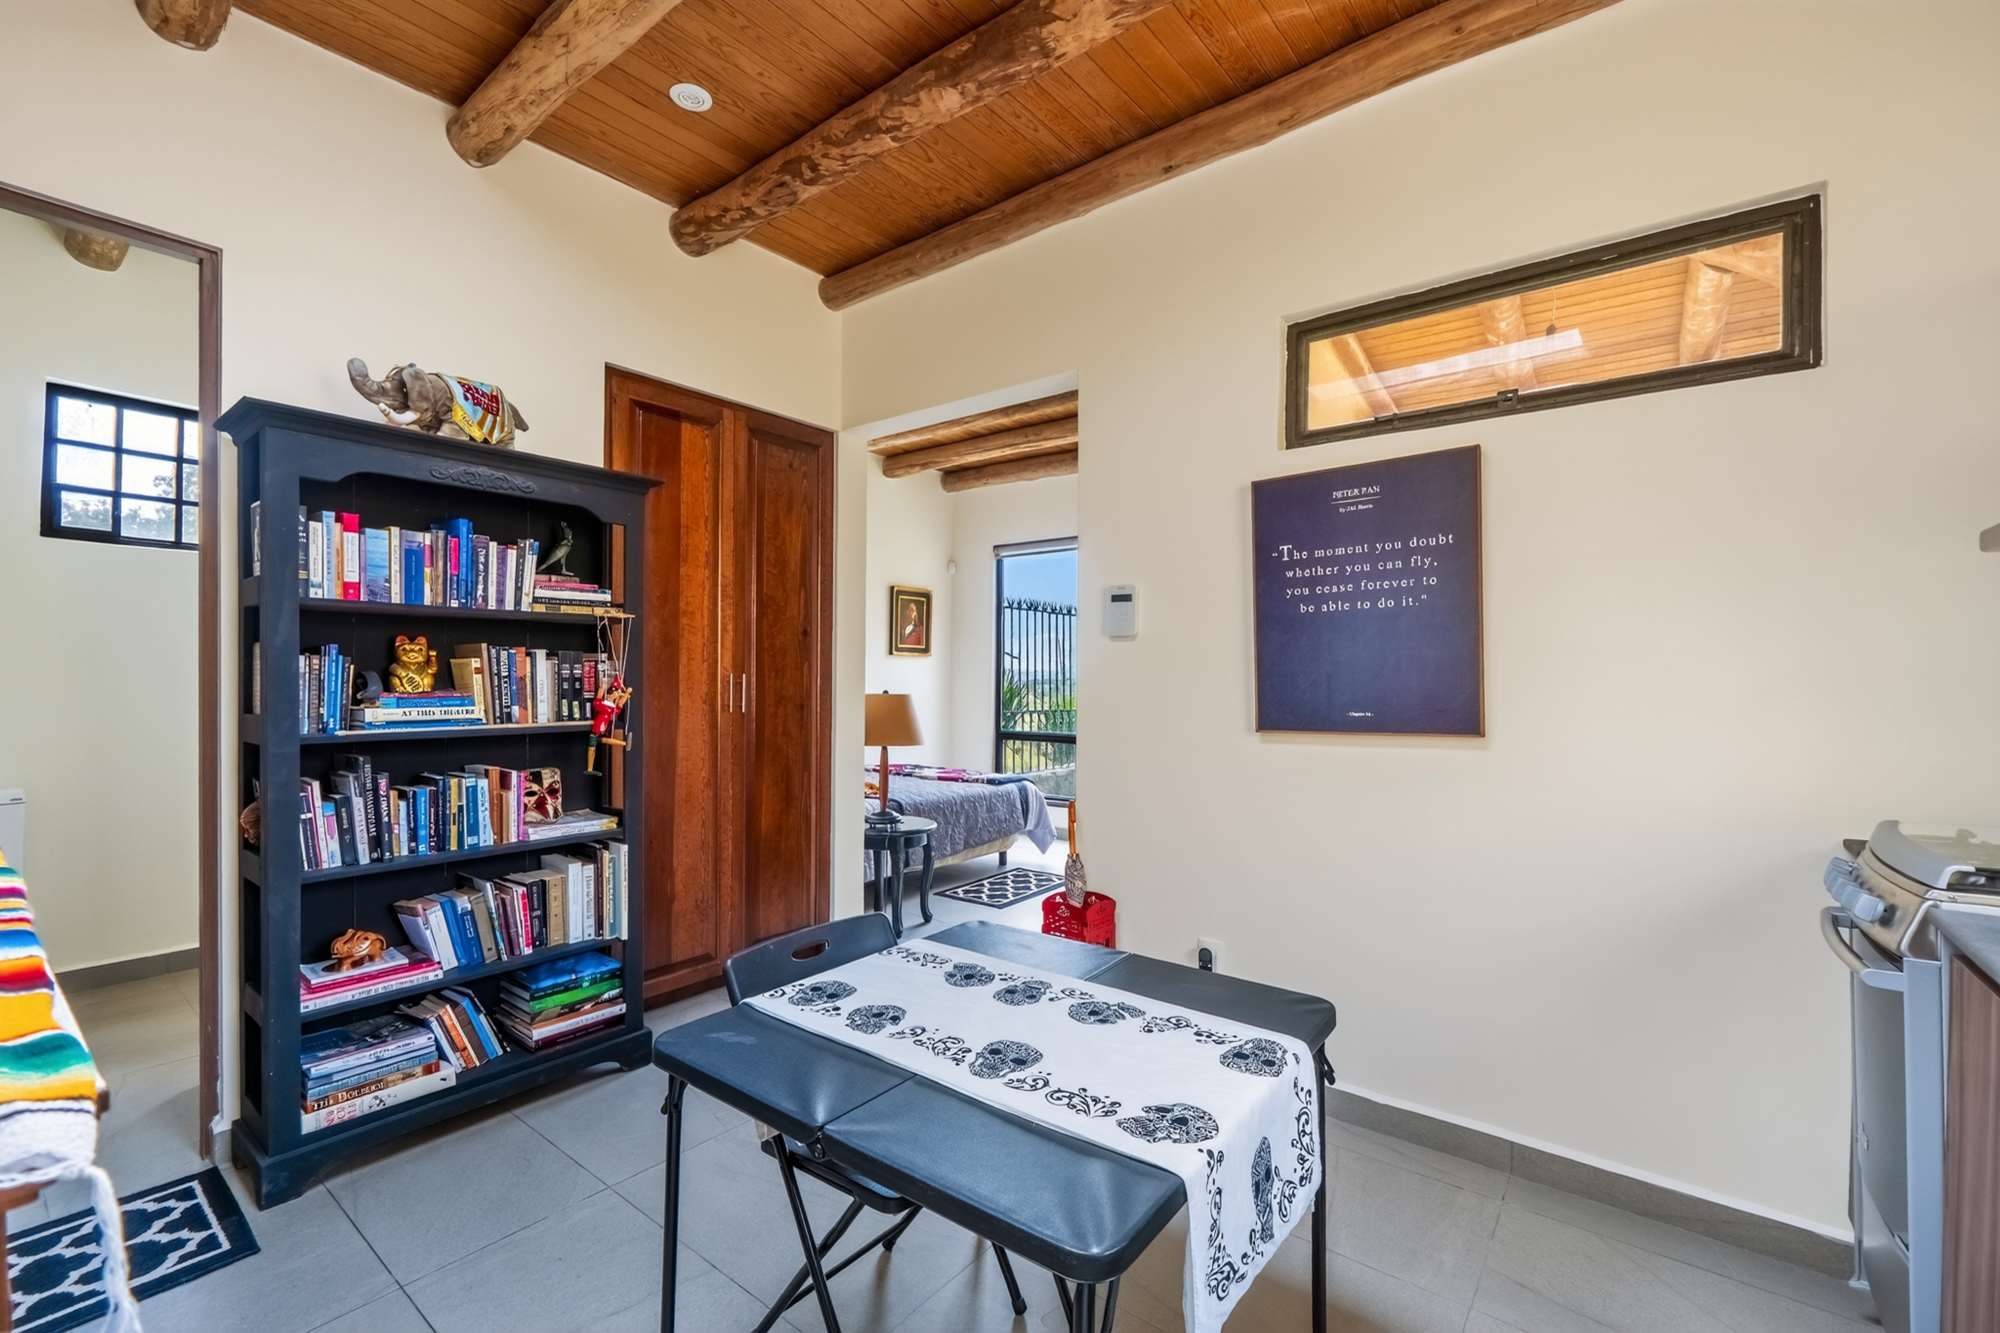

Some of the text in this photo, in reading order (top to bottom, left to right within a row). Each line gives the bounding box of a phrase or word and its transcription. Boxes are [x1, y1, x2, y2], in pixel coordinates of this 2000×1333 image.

[1332, 485, 1380, 499] PETER PAN
[1314, 543, 1368, 558] moment
[1375, 541, 1402, 554] you
[1409, 534, 1454, 547] doubt
[1285, 555, 1438, 578] whether you can fly,
[1286, 576, 1438, 598] you cease forever to
[1300, 603, 1315, 613] be
[1321, 600, 1351, 612] able
[1357, 600, 1371, 609] to
[1377, 597, 1395, 608] do
